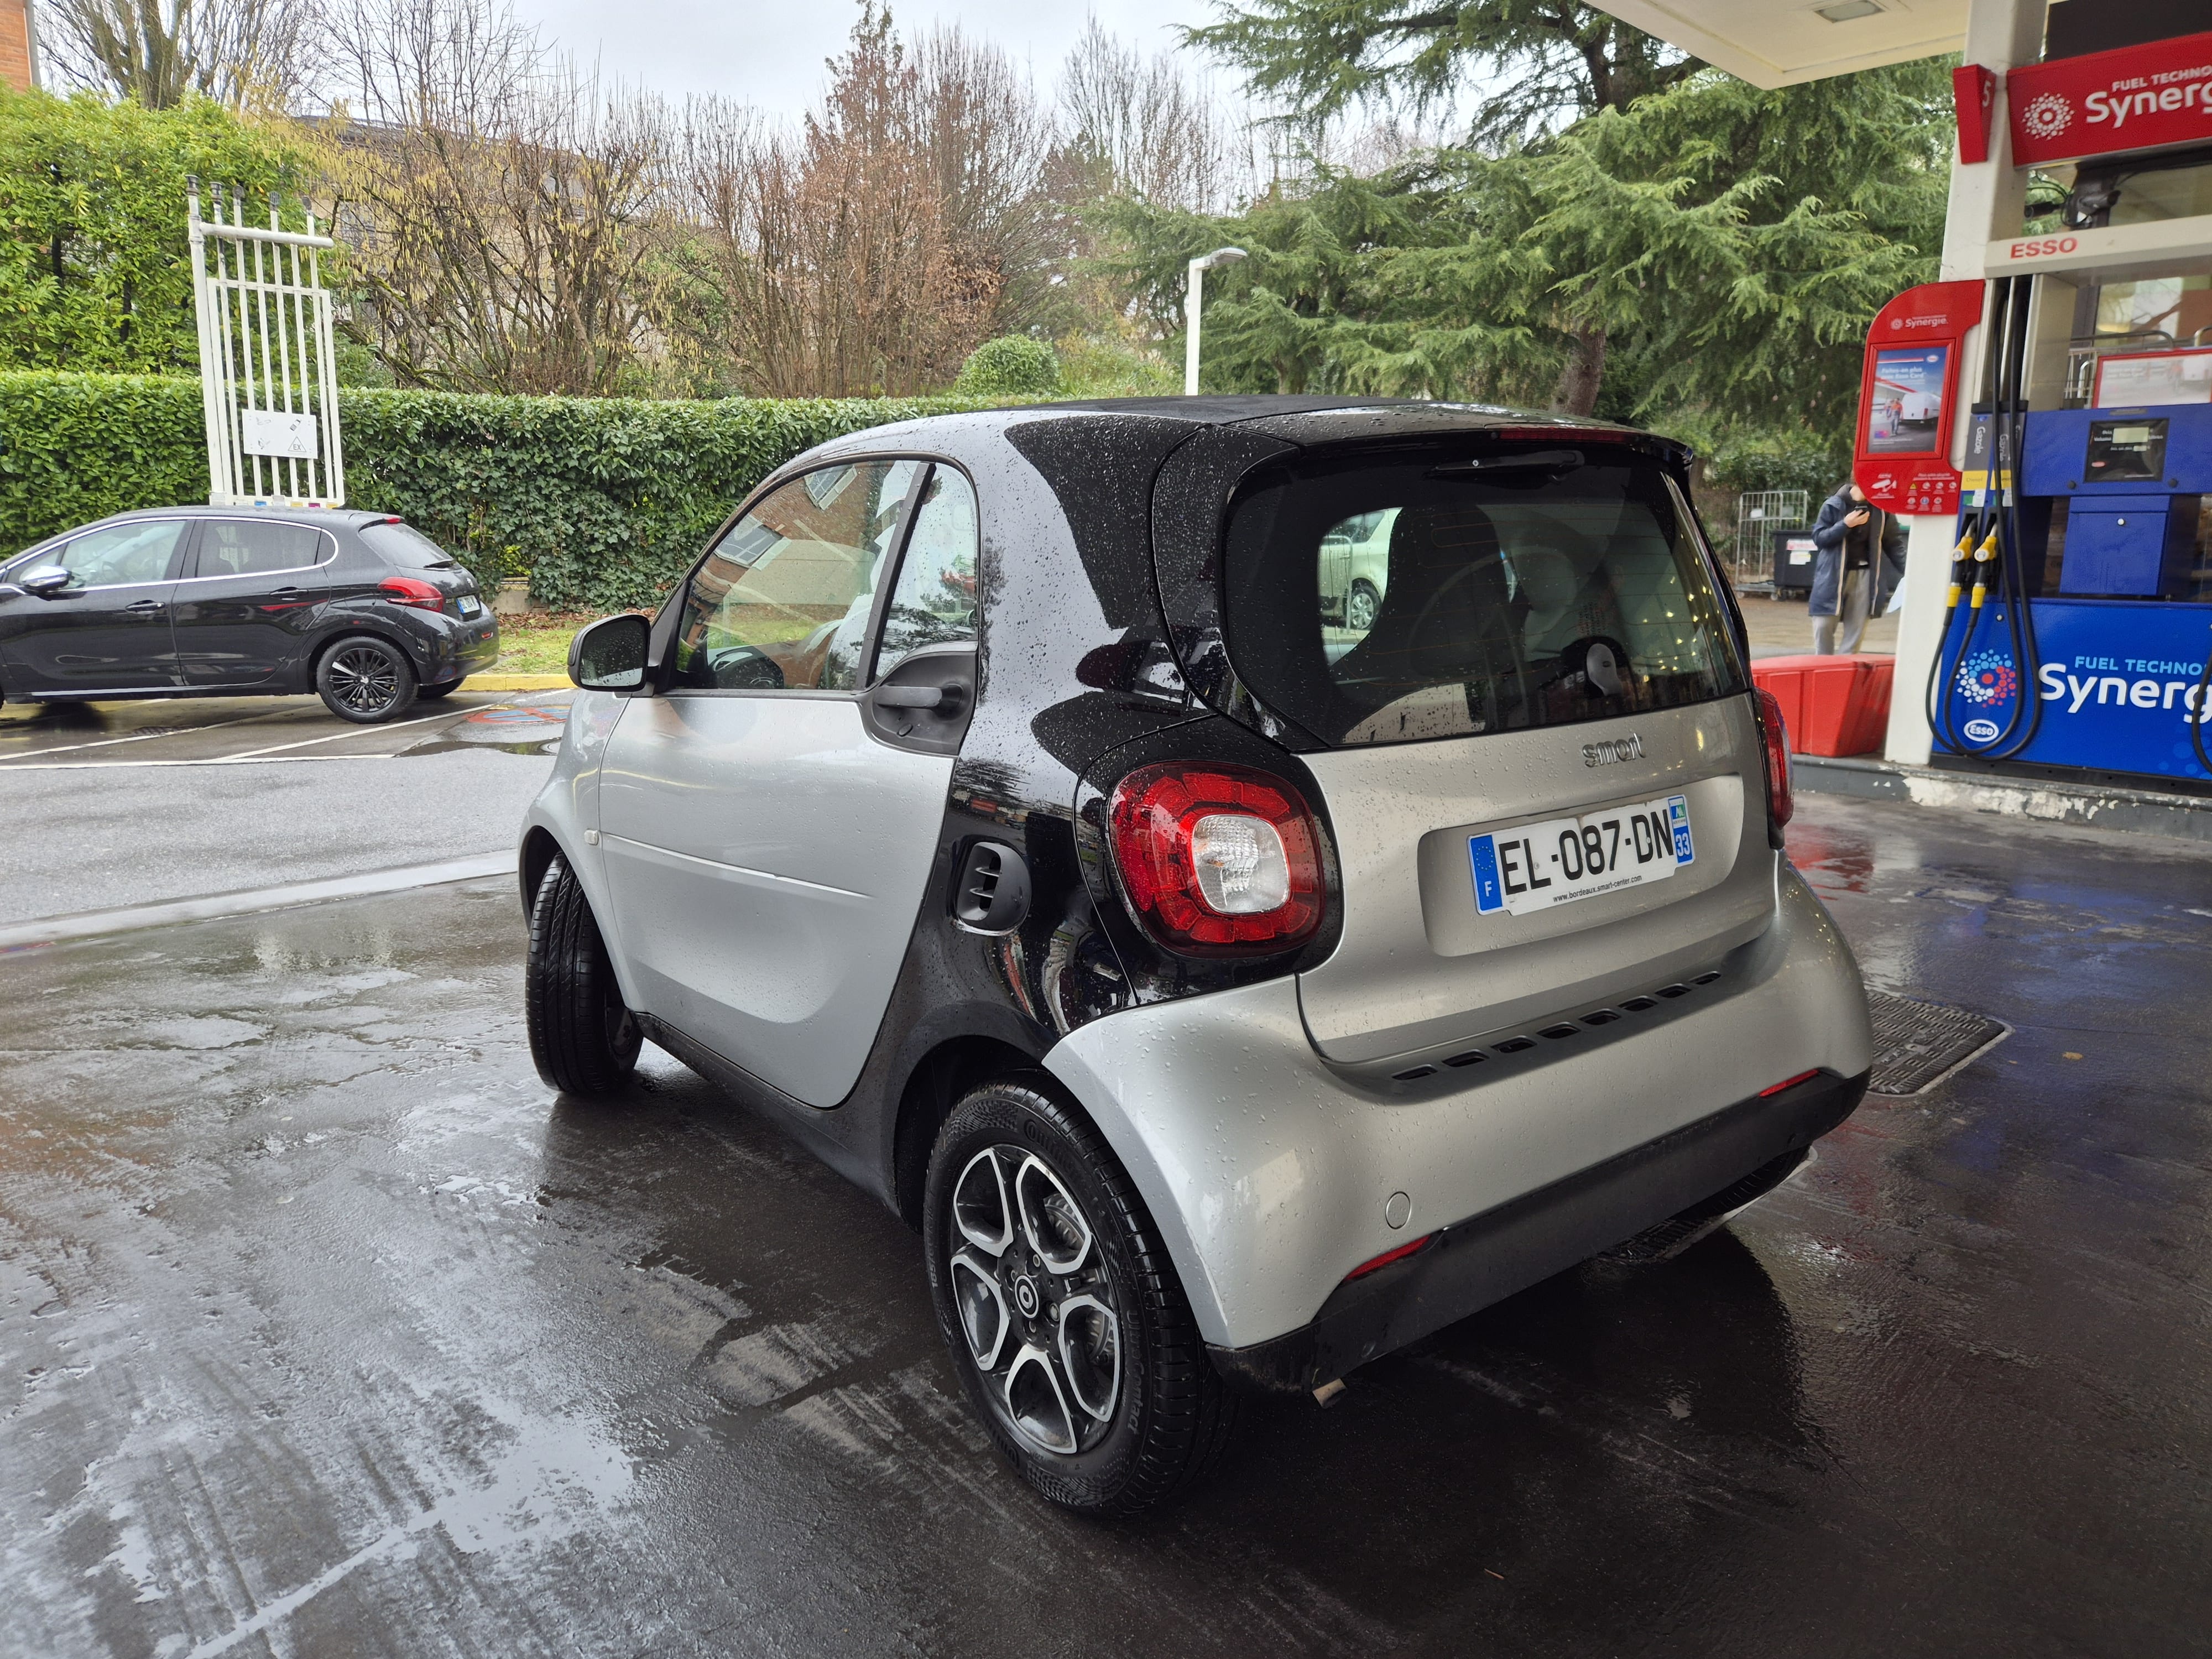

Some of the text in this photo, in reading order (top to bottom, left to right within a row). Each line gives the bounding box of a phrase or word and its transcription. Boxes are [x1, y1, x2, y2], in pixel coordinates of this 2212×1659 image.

[2112, 65, 2212, 92] FUEL TECHNO
[1982, 80, 1991, 107] 5
[2010, 237, 2078, 259] ESSO
[1905, 317, 1948, 328] Synergie
[1974, 426, 1986, 454] Gazole
[2075, 656, 2211, 676] FUEL TECHNO
[1582, 733, 1646, 768] smart
[1498, 809, 1674, 896] EL-087-DN
[1676, 832, 1691, 857] 33
[1484, 880, 1493, 897] F
[1553, 875, 1642, 902] www.bordeaux.smart-center.com
